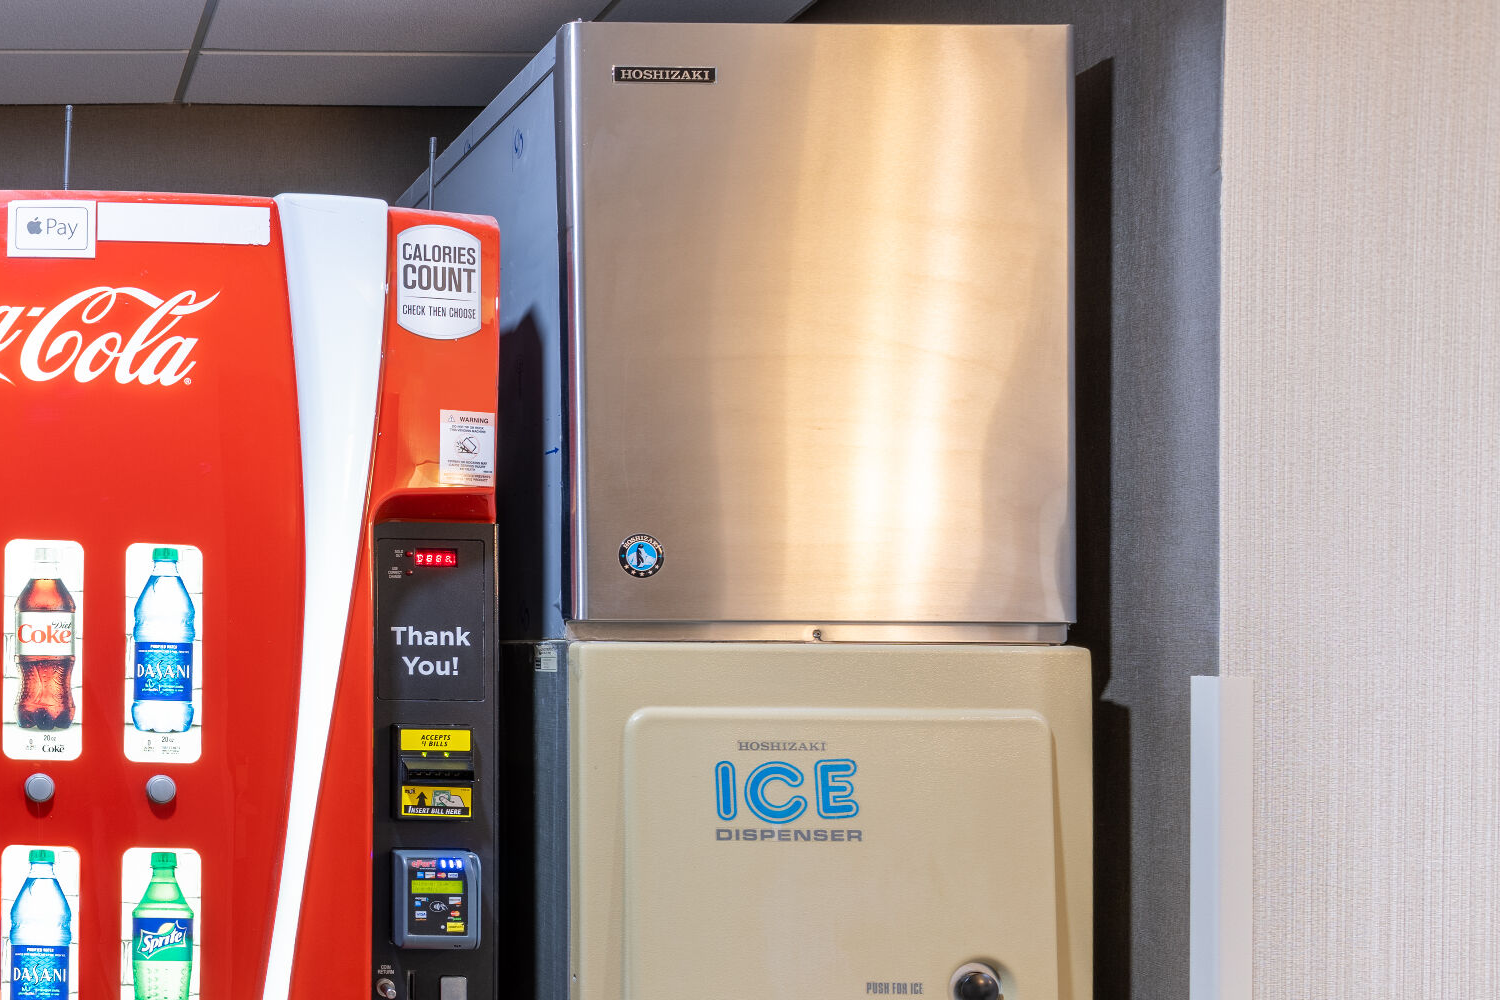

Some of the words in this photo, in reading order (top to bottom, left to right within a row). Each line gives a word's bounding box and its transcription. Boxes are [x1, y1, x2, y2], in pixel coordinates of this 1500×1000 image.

[620, 69, 710, 80] HOSHIZAKI
[46, 218, 78, 240] Pay
[402, 242, 476, 266] CALORIES
[402, 263, 476, 294] COUNT
[403, 303, 426, 316] CHECK
[428, 305, 447, 318] THEN
[449, 306, 477, 320] CHOOSE
[459, 416, 489, 424] WARNING
[17, 623, 72, 644] Coke
[51, 621, 72, 630] Diet
[390, 625, 471, 647] Thank
[137, 660, 190, 682] DASANI
[401, 656, 459, 676] You!
[41, 745, 65, 753] Coke
[738, 741, 827, 751] HOSHIZAKI
[715, 758, 860, 825] ICE
[408, 805, 429, 814] INSERT
[715, 828, 863, 842] DISPENSER
[141, 930, 183, 954] Sprite
[13, 963, 67, 985] DASANI
[866, 982, 890, 994] PUSH
[892, 982, 908, 994] FOR
[910, 982, 923, 995] ICE
